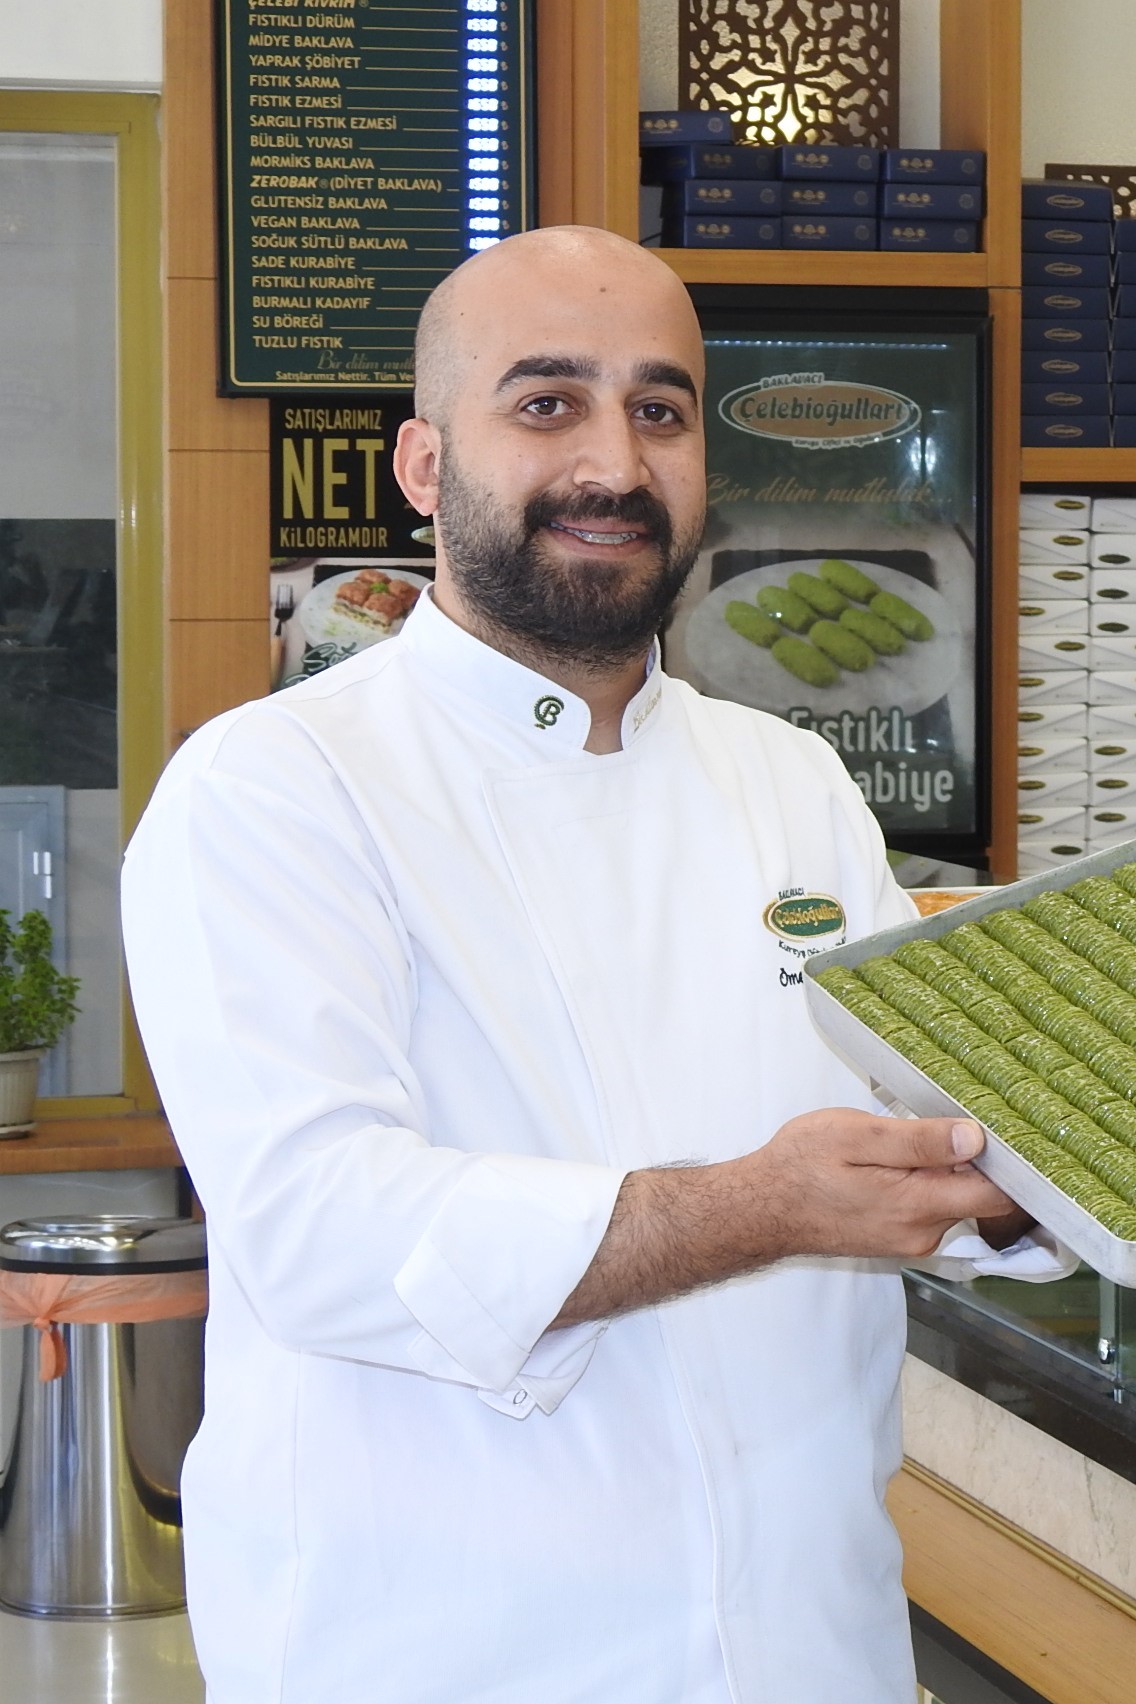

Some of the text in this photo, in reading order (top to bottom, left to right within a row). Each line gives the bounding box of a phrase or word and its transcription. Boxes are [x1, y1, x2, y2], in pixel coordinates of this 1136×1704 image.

[248, 13, 356, 29] FISTIKLI DÜRÜM
[248, 31, 354, 49] MİDYE BAKLAVA
[249, 53, 362, 71] YAPRAK ŞÖBİYET
[249, 74, 341, 89] FISTIK SARMA
[249, 94, 342, 109] FISTIK EZMESİ
[249, 114, 397, 130] SARGILI FISTIK EZMESİ
[250, 132, 353, 149] BÜLBÜL YUVASI
[250, 153, 375, 170] MORMİKS BAKLAVA
[329, 174, 375, 191] (DİYET
[377, 177, 442, 193] BAKLAVA)
[250, 193, 388, 210] GLUTENSİZ BAKLAVA
[250, 215, 361, 229] VEGAN BAKLAVA
[251, 233, 409, 250] SOĞUK SÜTLÜ BAKLAVA
[251, 254, 356, 270] SADE KURABİYE
[252, 274, 375, 290] FISTIKLI KURABİYE
[252, 295, 371, 309] BURMALI KADAYIF
[252, 313, 324, 329] SU BÖREĞİ
[252, 335, 343, 349] TUZLU FISTIK
[285, 408, 382, 432] SATIŞLARIMIZ
[282, 437, 385, 520] NET
[754, 476, 818, 504] dilim
[854, 760, 954, 813] abiye
